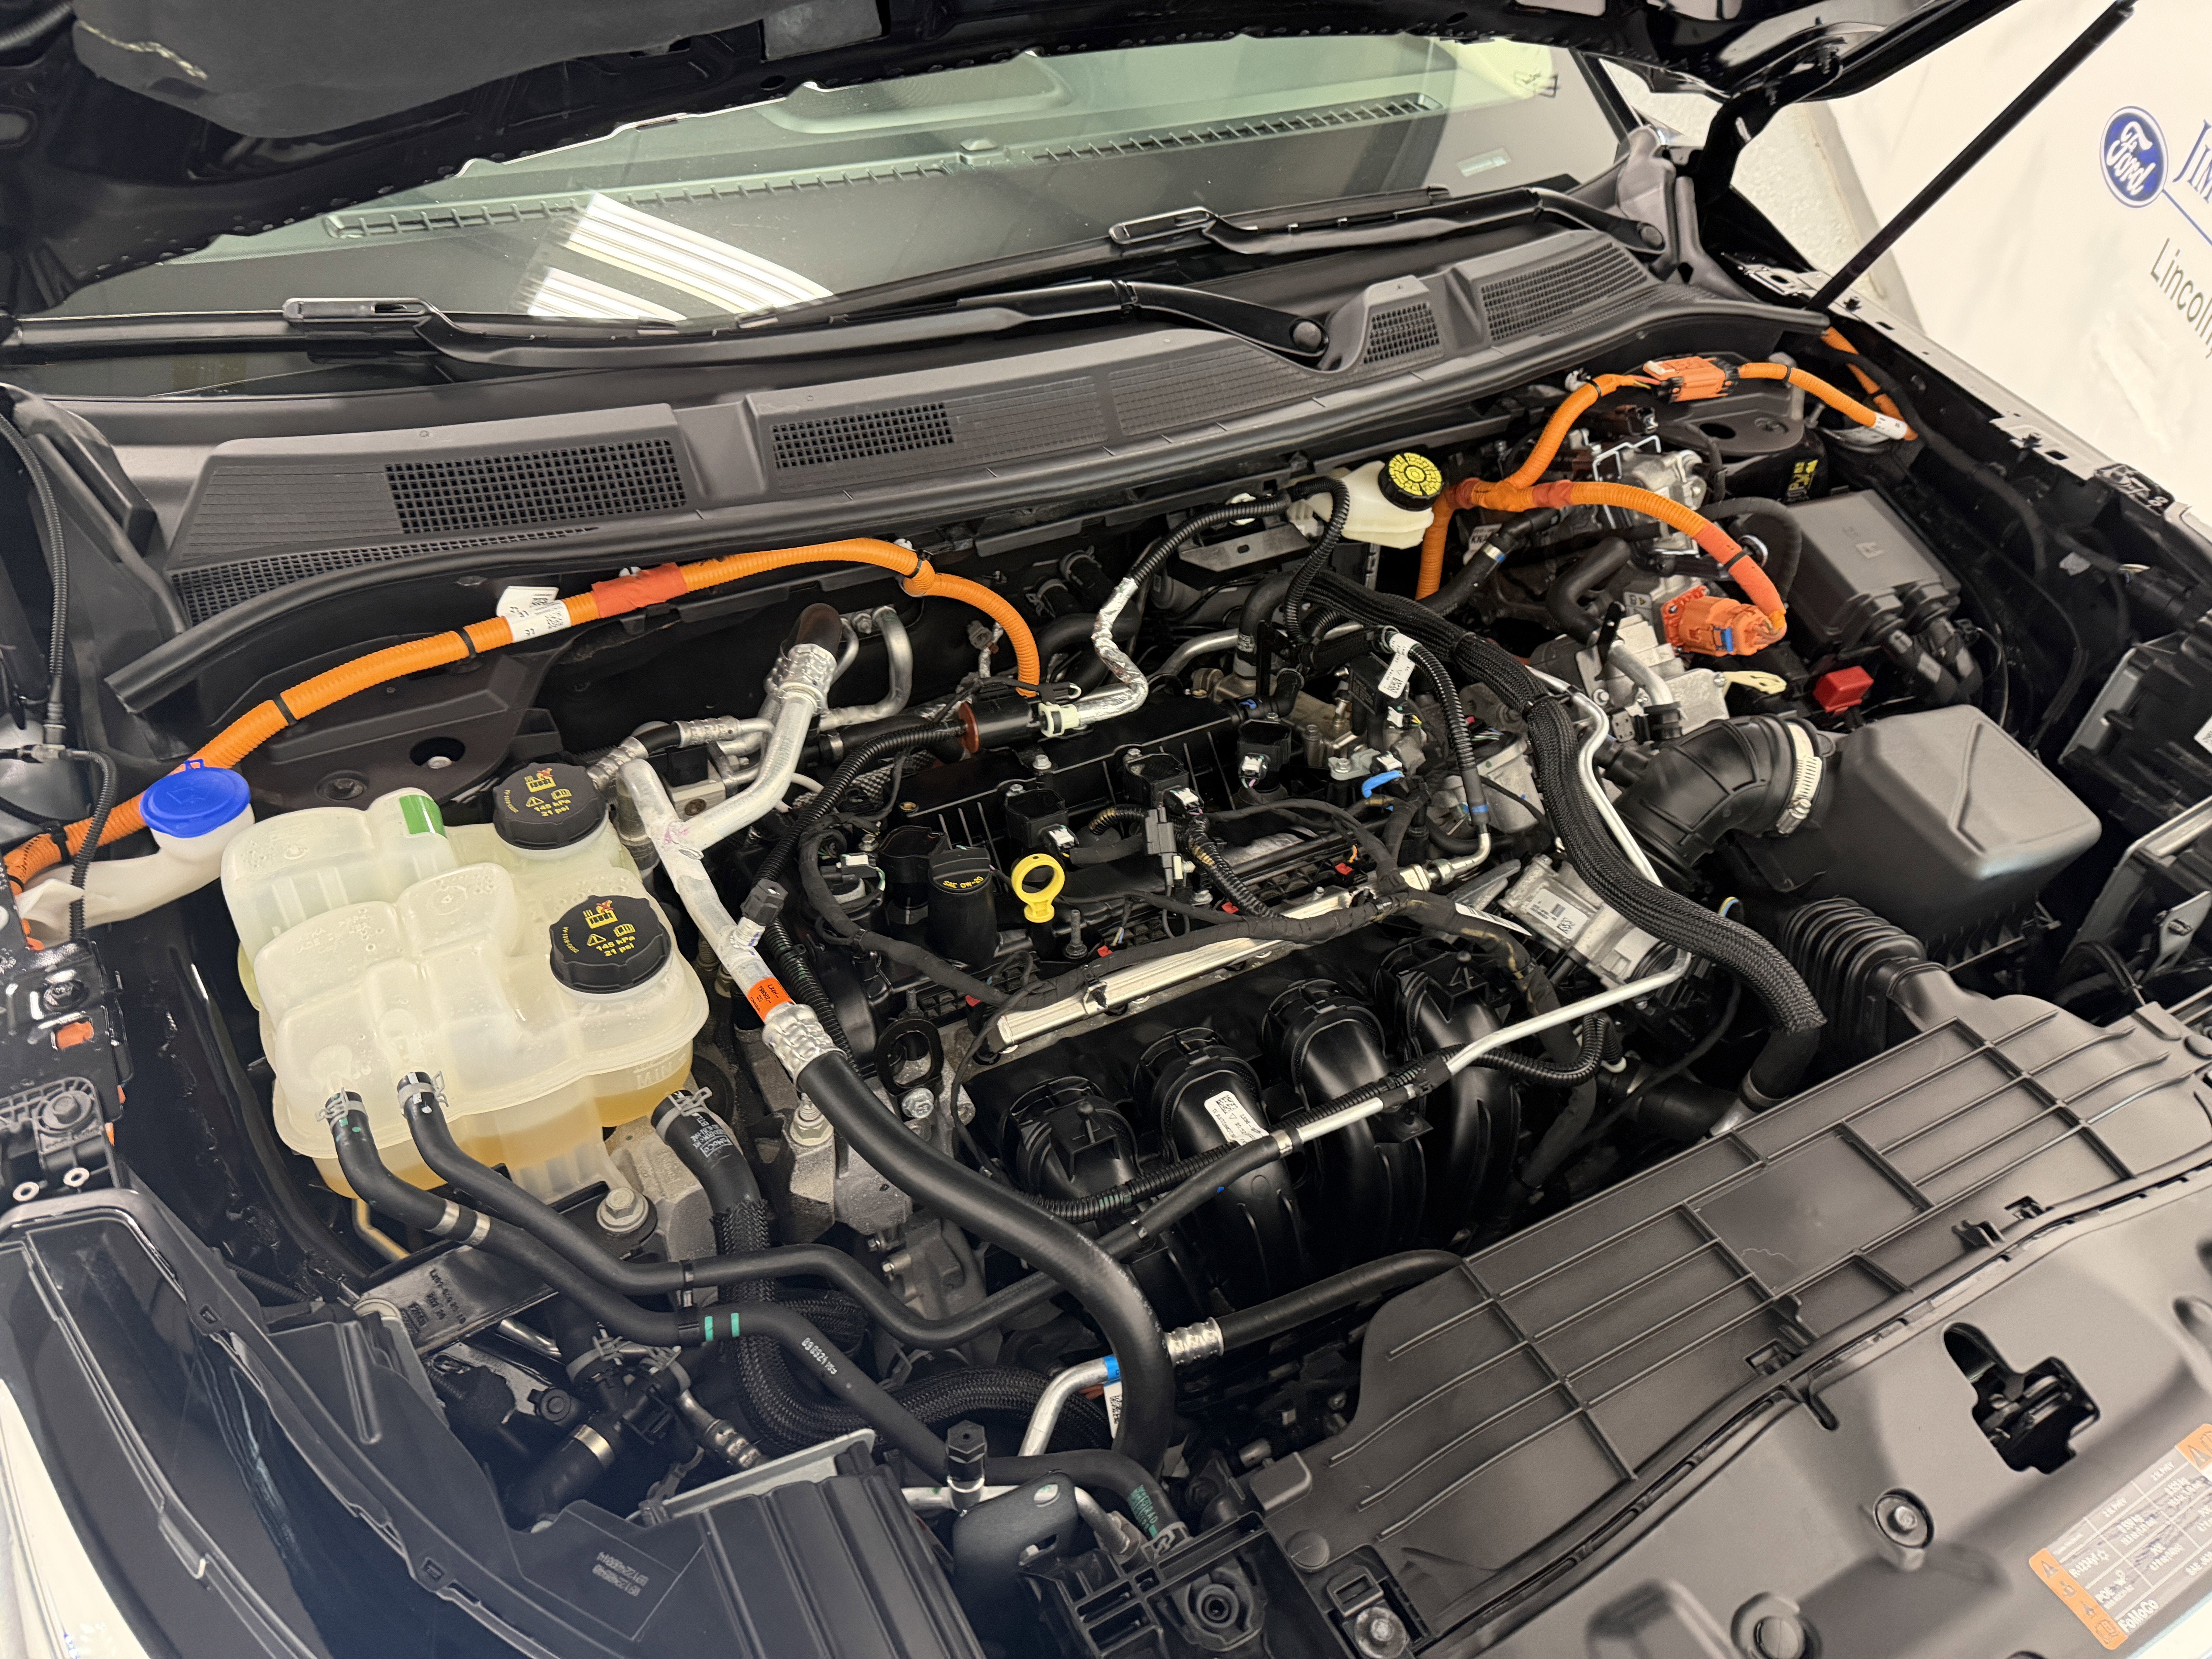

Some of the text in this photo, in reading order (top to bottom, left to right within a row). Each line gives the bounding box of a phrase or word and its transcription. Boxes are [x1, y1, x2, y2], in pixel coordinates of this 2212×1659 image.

[2106, 121, 2157, 196] Ford
[534, 804, 552, 812] 145
[555, 805, 570, 814] psi
[960, 876, 984, 888] 0W-20
[596, 936, 635, 951] 145 kPa
[604, 943, 635, 957] 21 psi
[2117, 1599, 2159, 1633] FoMoCo
